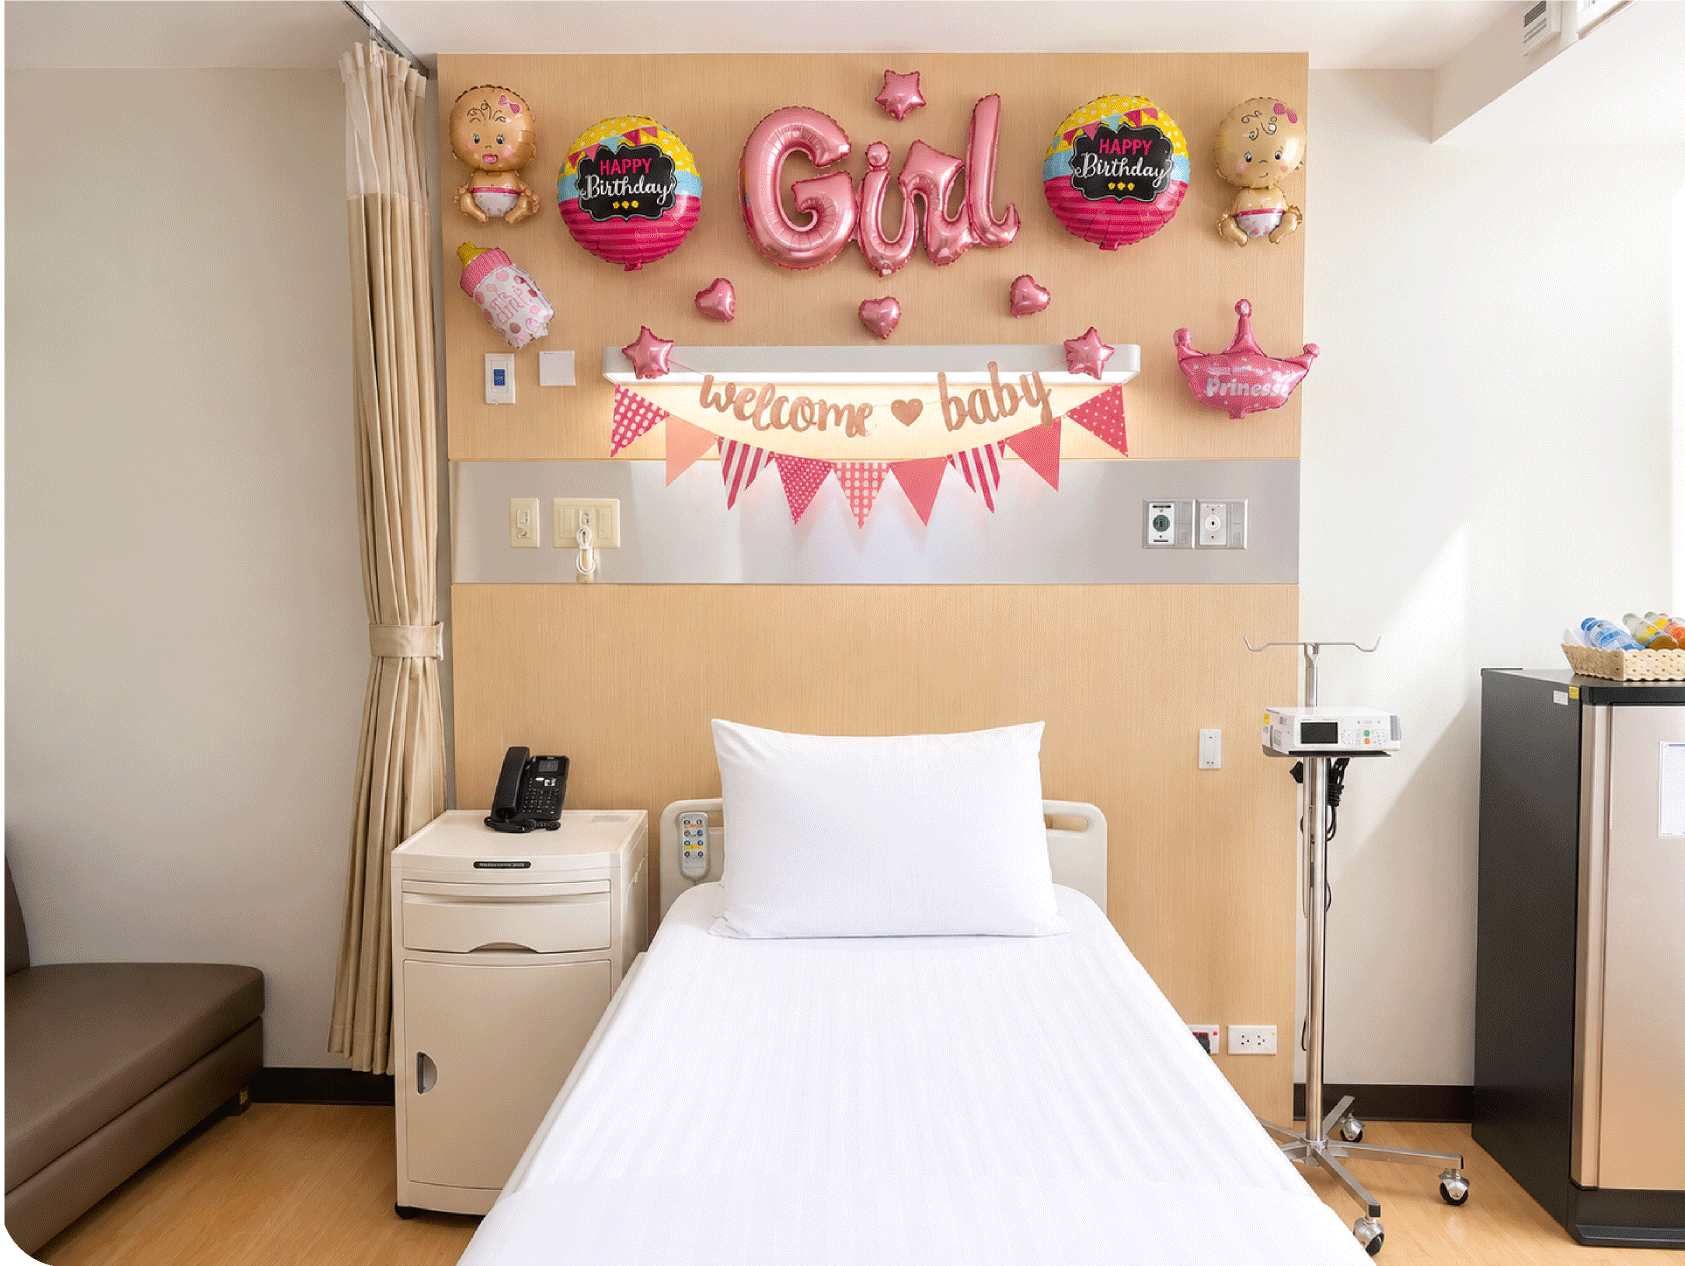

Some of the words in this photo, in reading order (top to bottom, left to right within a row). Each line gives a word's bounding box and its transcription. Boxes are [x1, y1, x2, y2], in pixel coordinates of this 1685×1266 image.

[1099, 138, 1152, 155] HAPPY
[600, 158, 652, 175] HAPPY
[1074, 151, 1173, 188] Birthday
[579, 174, 676, 206] Birthday
[738, 93, 1021, 278] Girl
[699, 374, 874, 438] welcome
[937, 361, 1053, 431] baby
